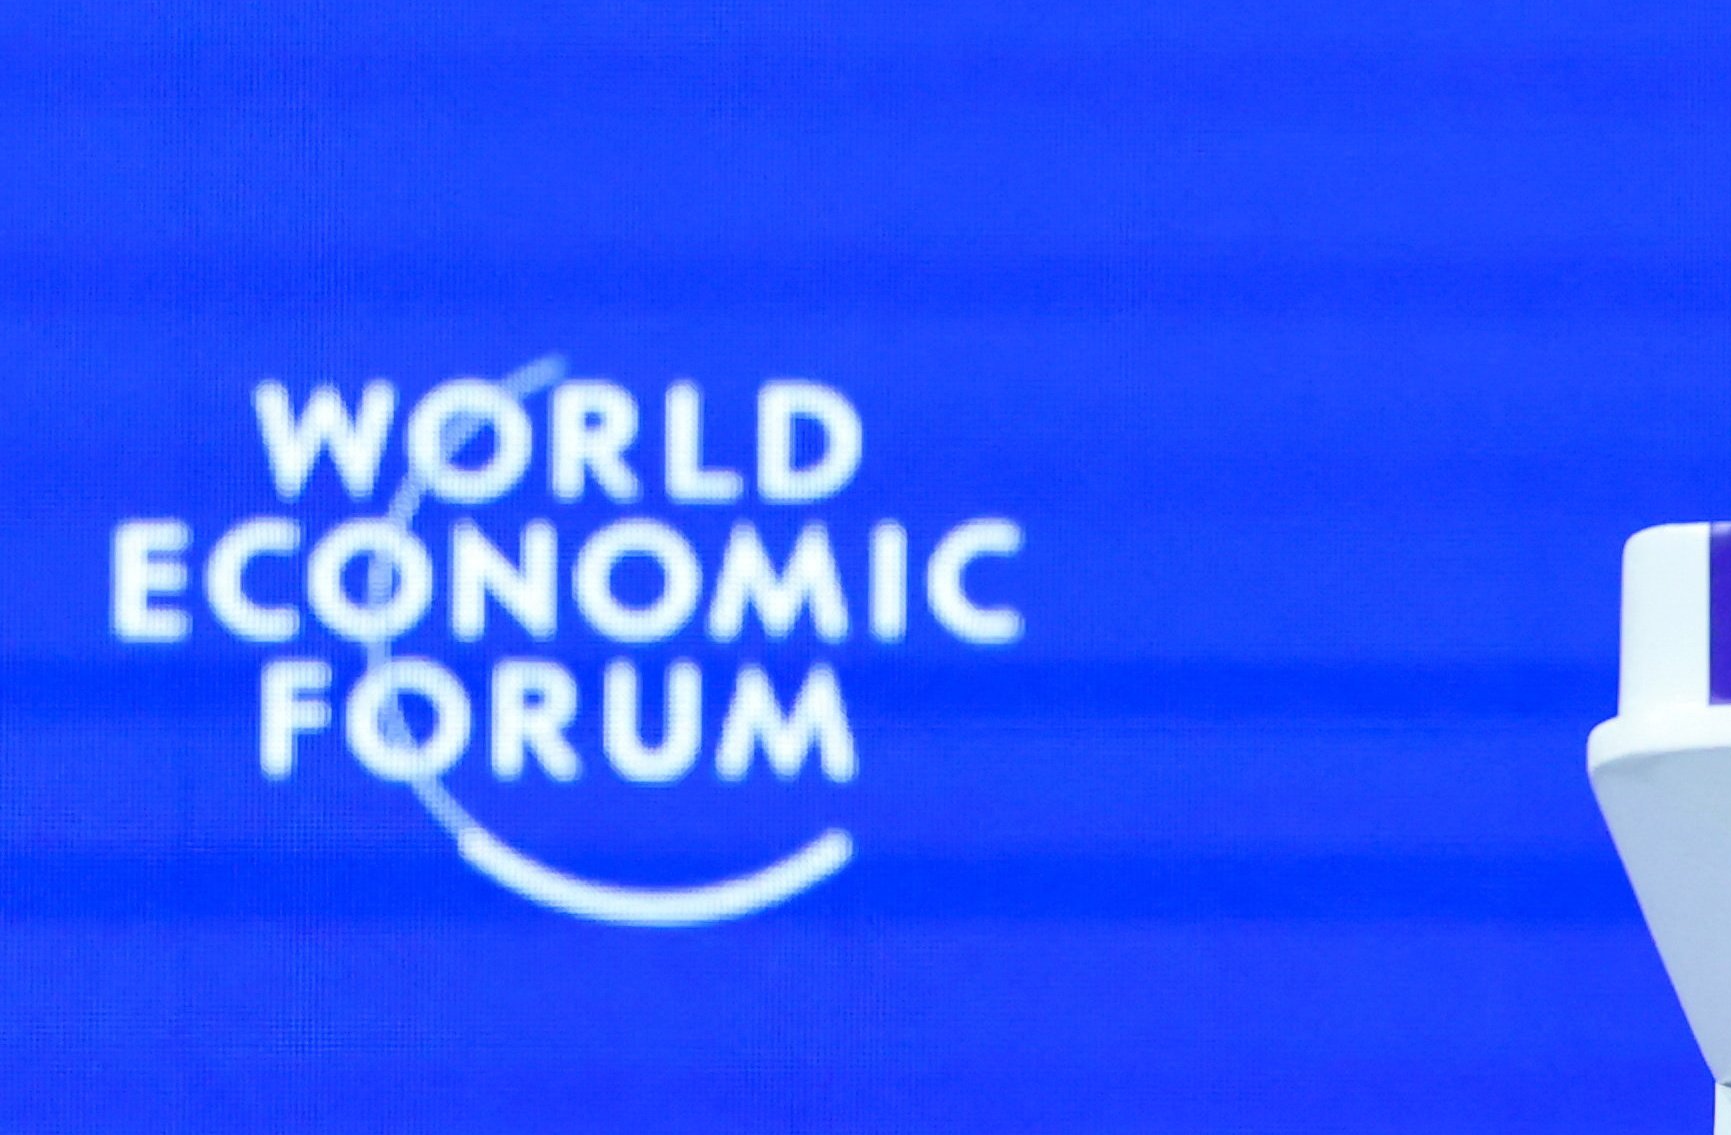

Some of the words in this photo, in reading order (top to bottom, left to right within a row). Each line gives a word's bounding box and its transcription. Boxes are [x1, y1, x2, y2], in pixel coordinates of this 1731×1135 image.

[253, 377, 863, 503] WORLD
[112, 516, 1025, 645] ECONOMIC
[259, 657, 858, 784] FORUM
